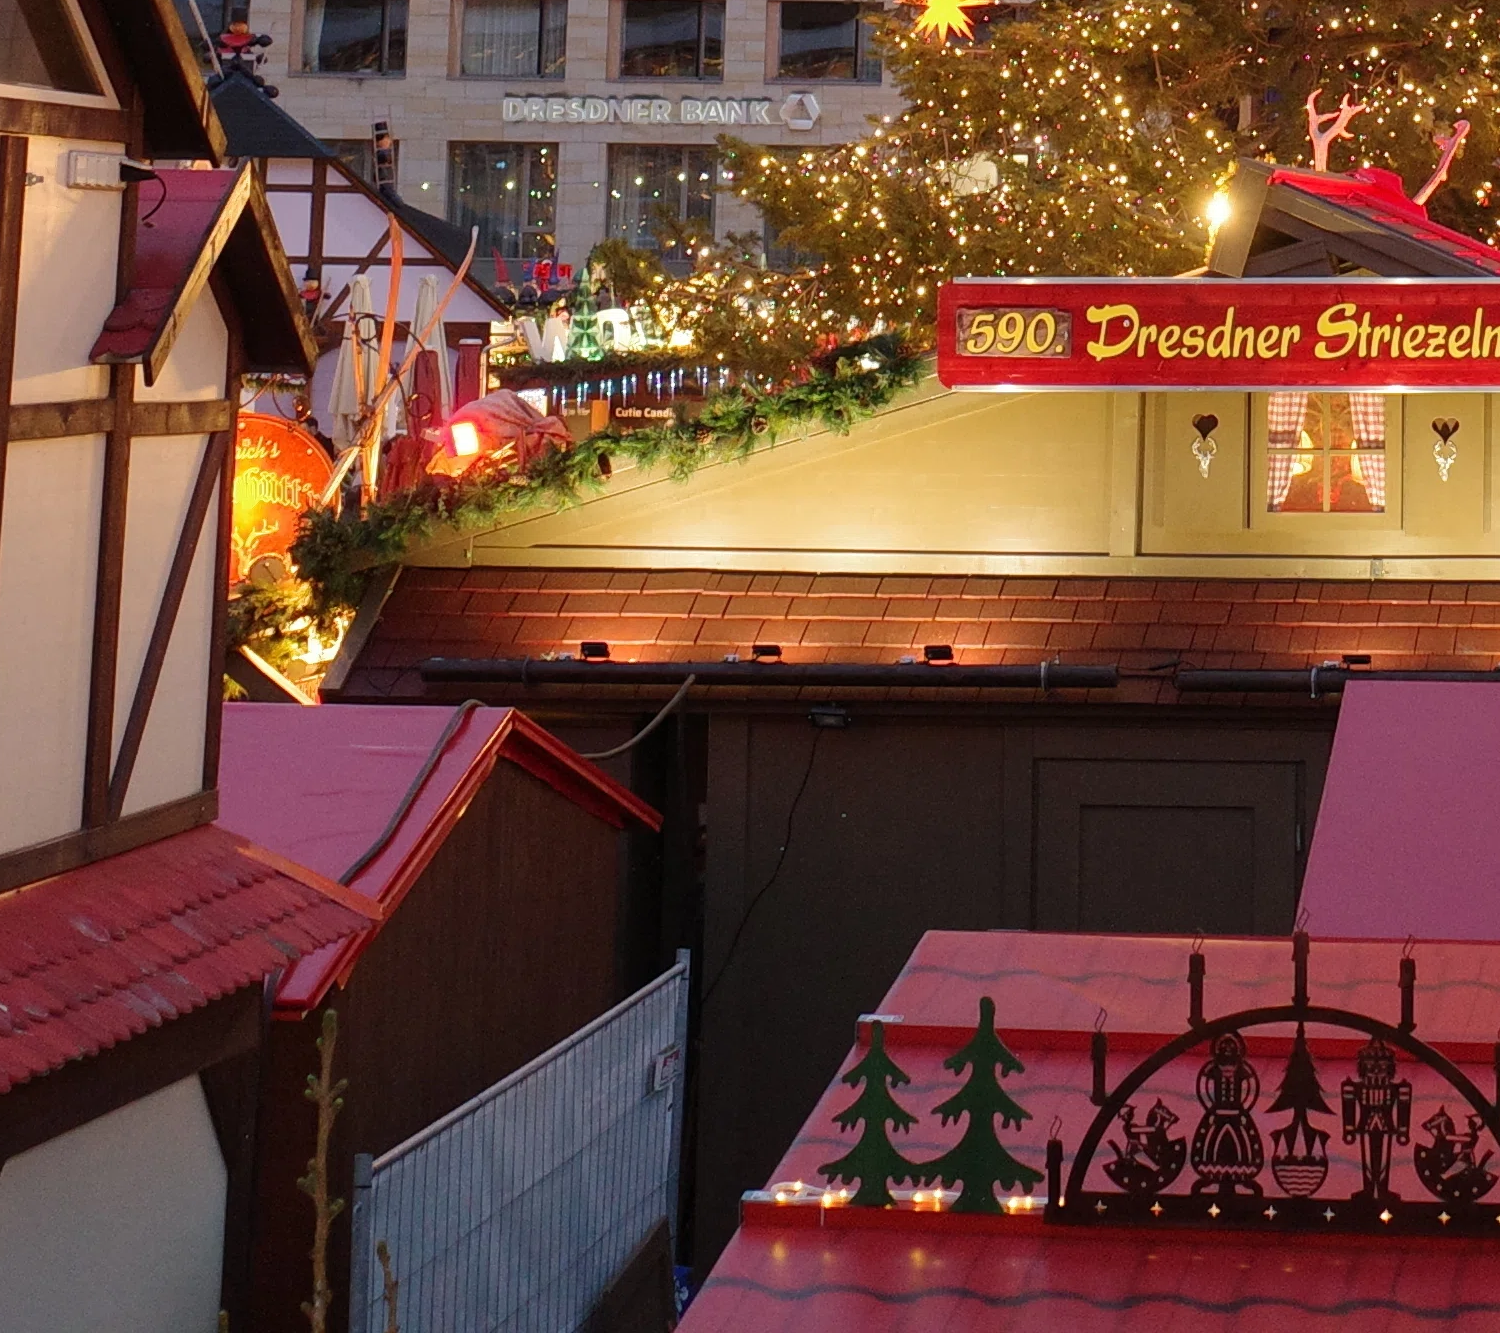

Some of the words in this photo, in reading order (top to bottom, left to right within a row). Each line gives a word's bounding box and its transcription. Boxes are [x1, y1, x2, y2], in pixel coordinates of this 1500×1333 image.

[502, 96, 672, 124] DRESDNER
[681, 98, 771, 125] BANK
[965, 311, 1065, 354] 590.
[1086, 303, 1301, 361] Dresdner
